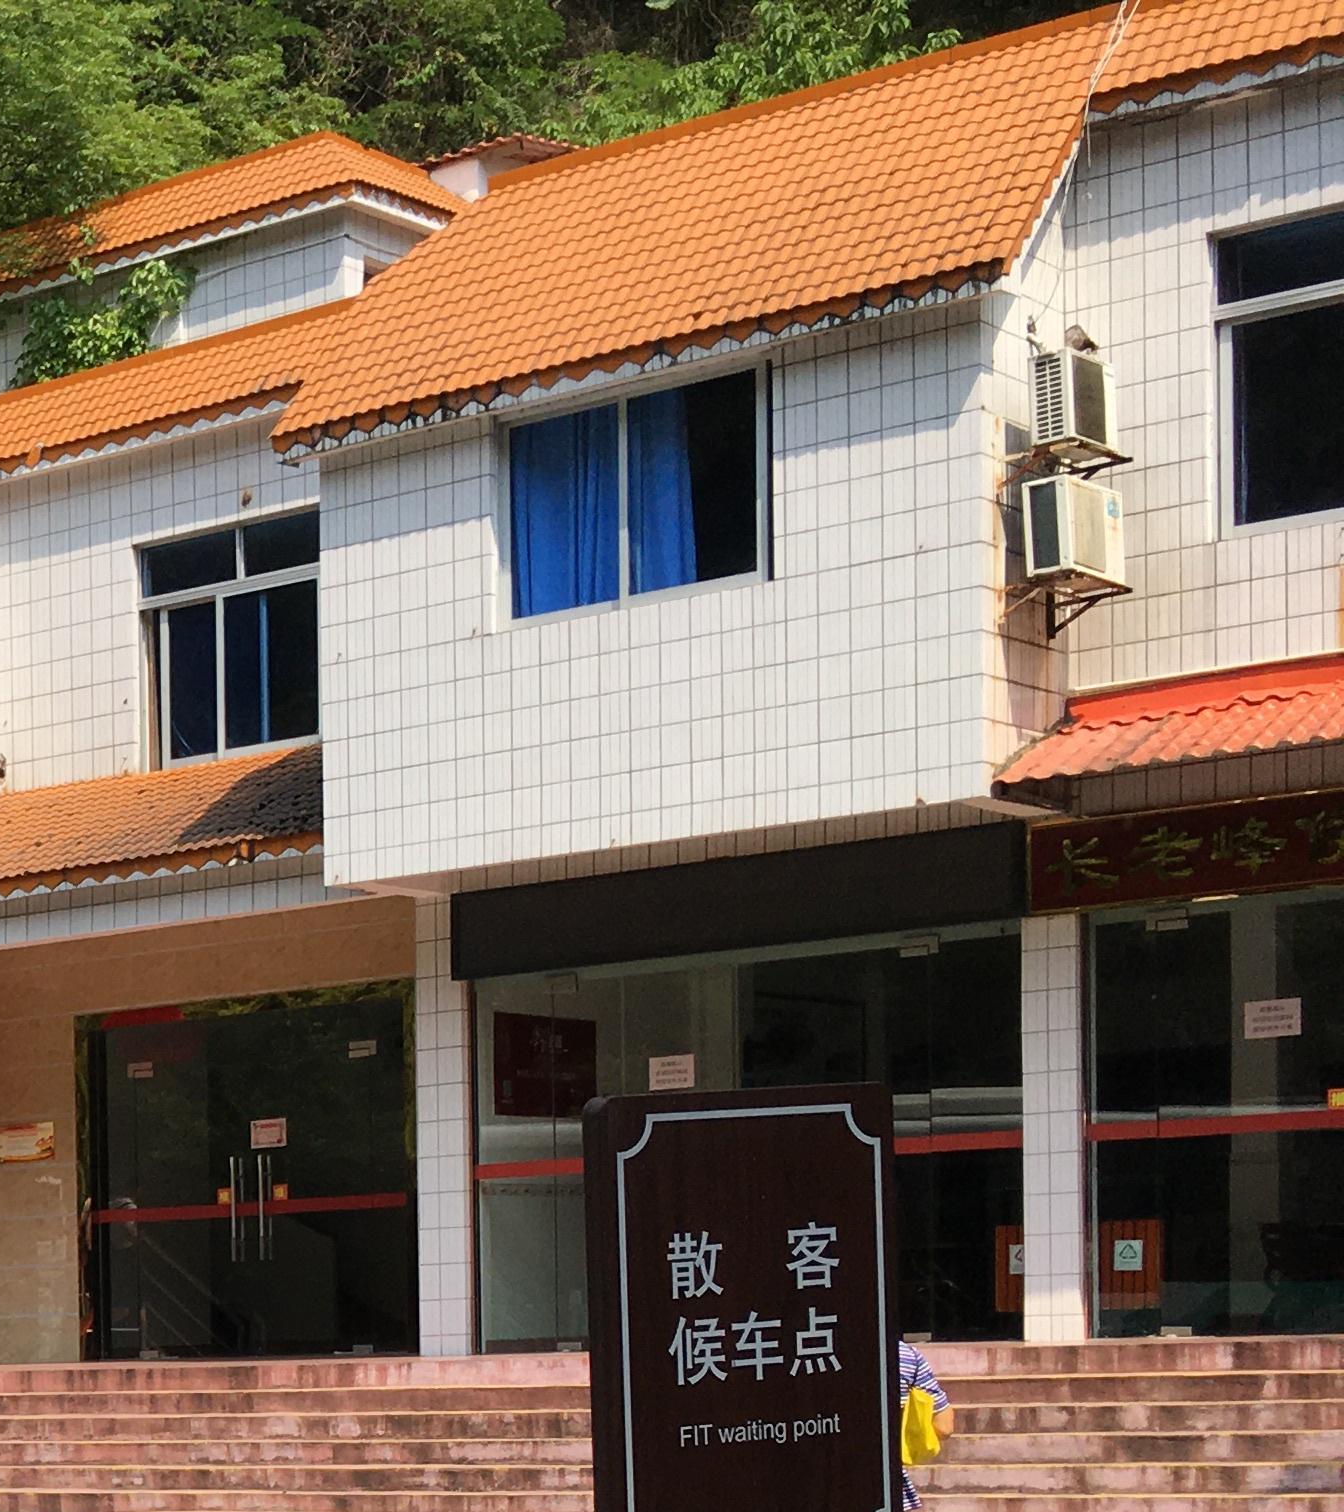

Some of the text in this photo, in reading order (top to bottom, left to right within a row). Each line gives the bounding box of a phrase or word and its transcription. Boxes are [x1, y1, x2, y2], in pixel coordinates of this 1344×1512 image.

[667, 1222, 840, 1299] 散客
[668, 1307, 842, 1385] 候车点
[680, 1413, 841, 1447] FIT waiting point
